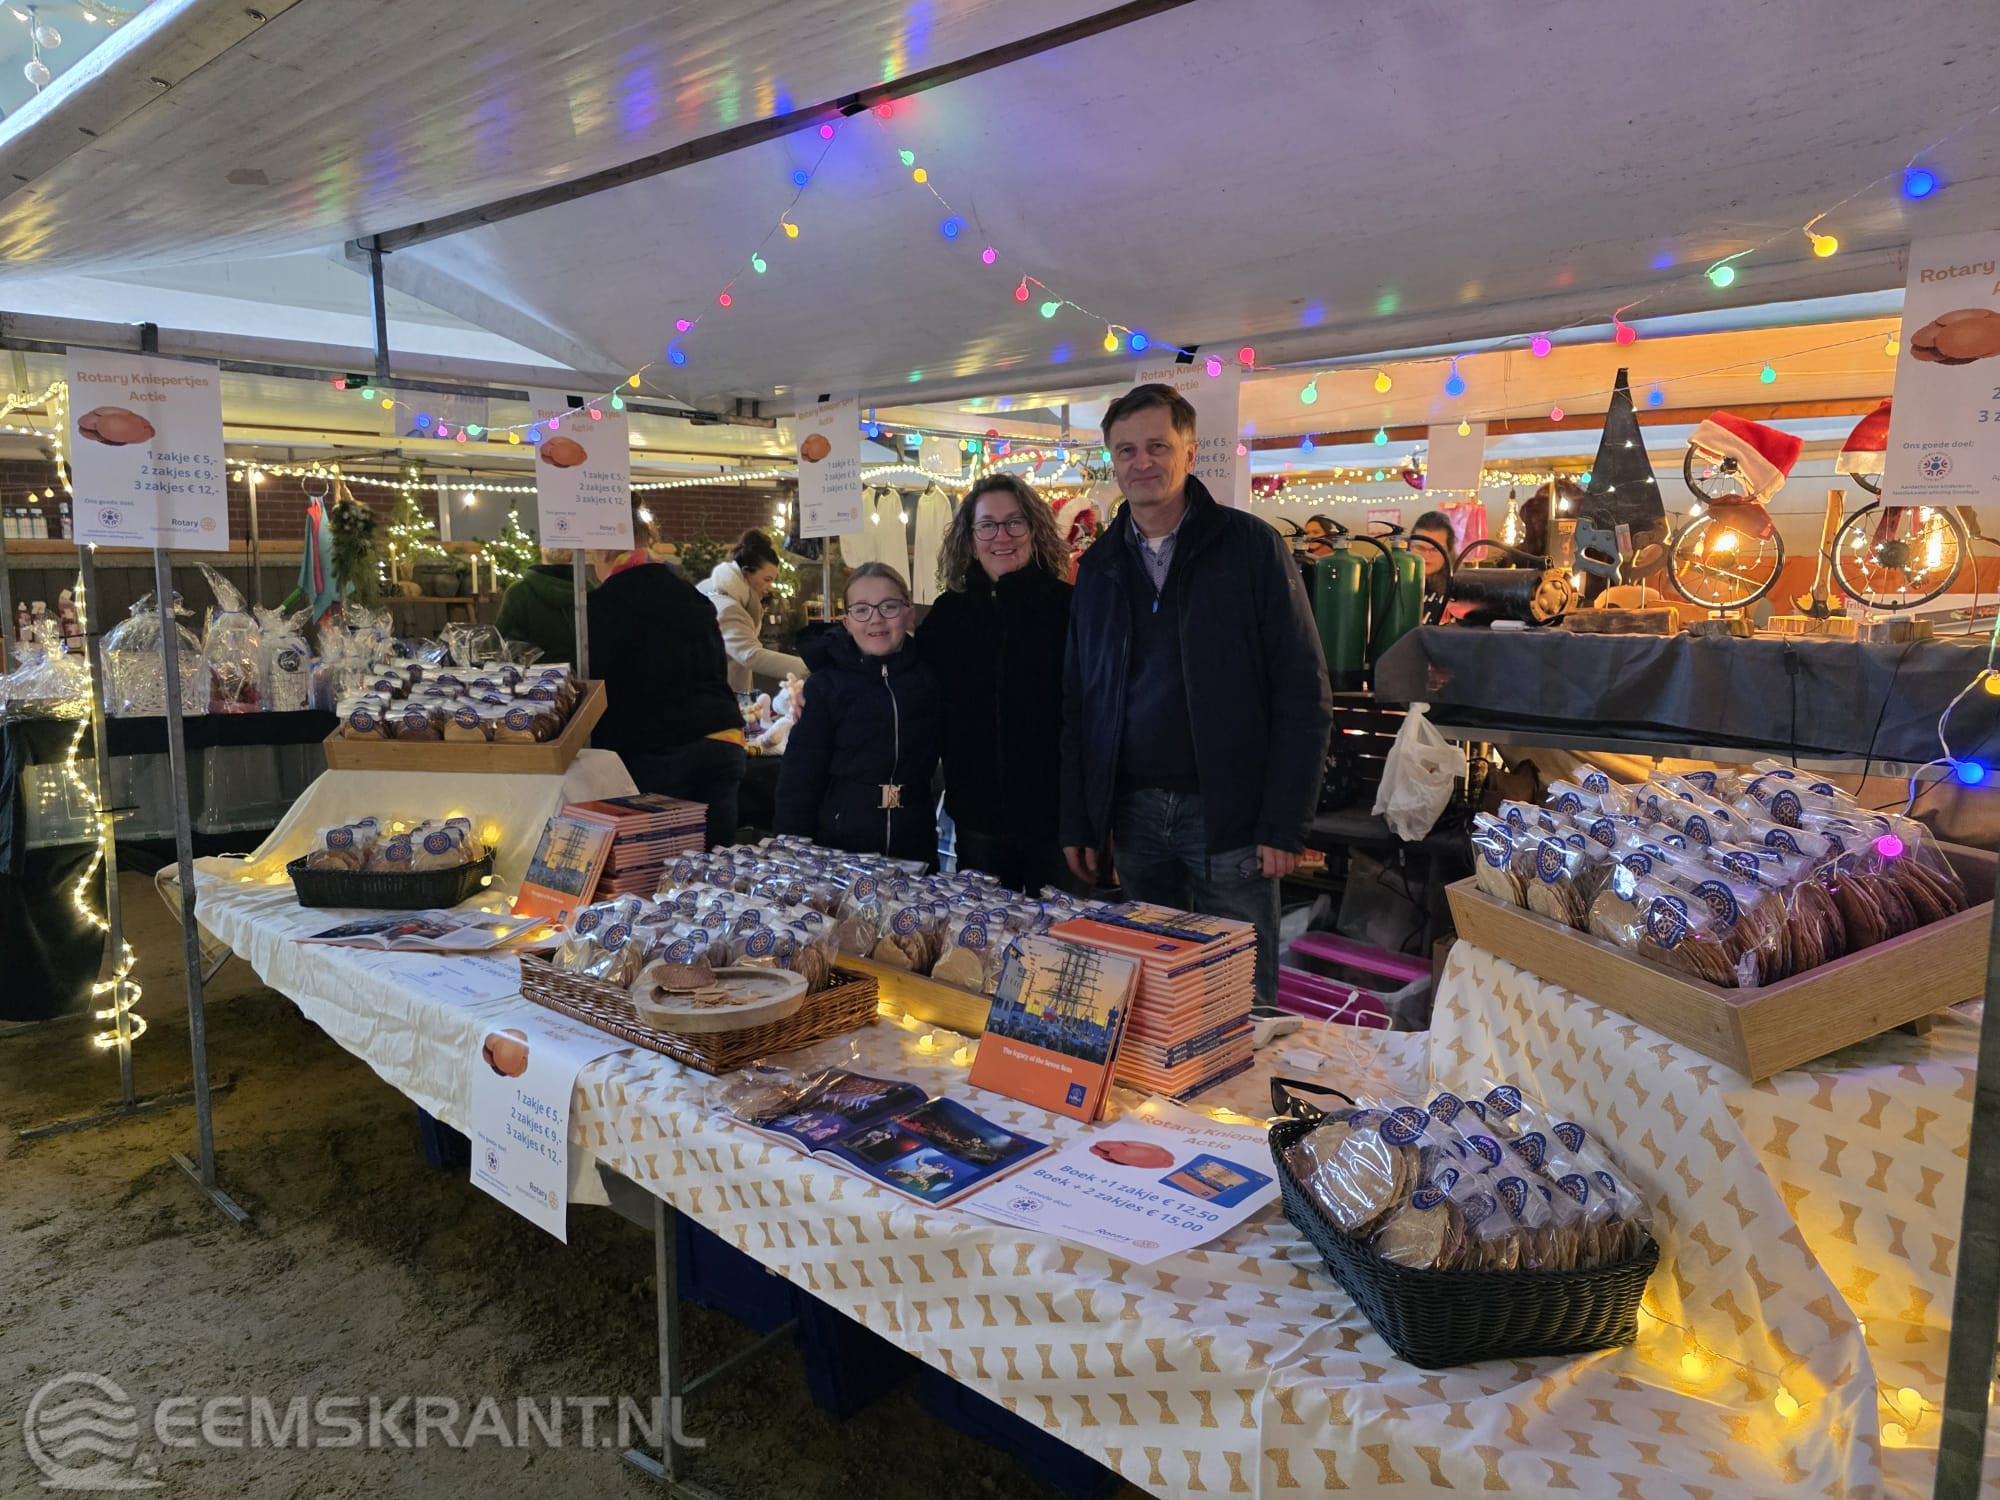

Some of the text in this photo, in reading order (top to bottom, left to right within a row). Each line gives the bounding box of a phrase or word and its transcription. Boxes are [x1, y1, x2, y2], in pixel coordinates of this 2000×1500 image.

[1919, 260, 1995, 284] Rotary
[76, 371, 209, 388] Rotary Kniepertjes
[1141, 368, 1175, 382] Rotary
[1173, 380, 1199, 393] Actie
[129, 391, 167, 402] Actie
[1978, 410, 1989, 423] 3
[1213, 438, 1218, 446] €
[1220, 438, 1232, 448] 5,-
[1921, 440, 1950, 450] goede
[147, 451, 218, 466] 1 zakje € 5,-
[1212, 453, 1218, 462] €
[1219, 453, 1231, 463] 9,-
[141, 465, 219, 480] 2 zakjes € 9,-
[589, 472, 609, 480] zakje
[1206, 469, 1212, 478] €
[1215, 469, 1230, 480] 12,-
[134, 480, 220, 496] 3 zakjes € 12,-
[579, 483, 585, 491] 2
[586, 484, 610, 493] zakjes
[582, 495, 607, 505] zakjes
[171, 518, 199, 529] Rotary
[516, 1089, 563, 1125] 1 zakje € 5,-
[511, 1106, 562, 1146] 2 zakjes € 9,-
[1139, 1113, 1269, 1145] Rotary Knieper
[506, 1123, 512, 1136] 3
[512, 1128, 539, 1151] zakjes
[540, 1143, 546, 1156] €
[1184, 1137, 1232, 1150] Actie
[529, 1181, 548, 1201] Rotary
[1059, 1165, 1098, 1182] Boek
[1116, 1184, 1160, 1202] zakje
[1162, 1198, 1176, 1207] €
[1176, 1202, 1220, 1222] 12,50
[1032, 1169, 1071, 1187] Boek
[1081, 1187, 1096, 1196] 2
[1093, 1192, 1145, 1213] zakjes
[1146, 1209, 1160, 1217] €
[1160, 1213, 1204, 1232] 15,00
